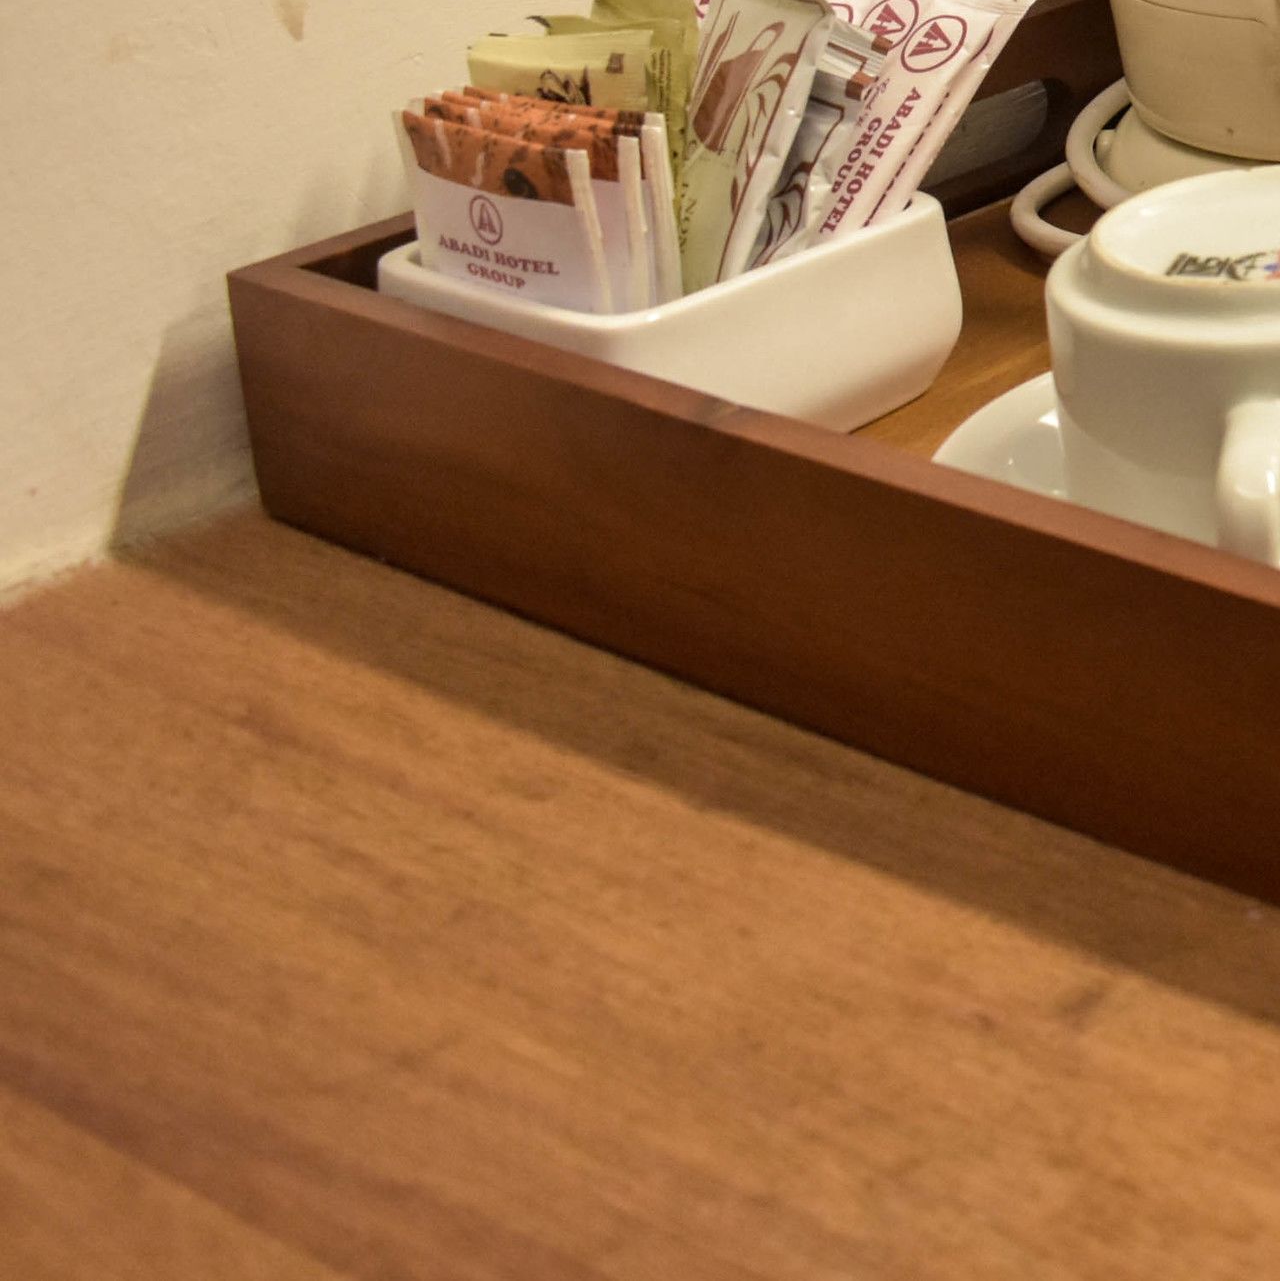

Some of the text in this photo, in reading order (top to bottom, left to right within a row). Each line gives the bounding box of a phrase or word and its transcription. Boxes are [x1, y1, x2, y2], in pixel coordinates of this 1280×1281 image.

[832, 117, 882, 194] GROUP
[870, 87, 922, 158] ABADI
[820, 162, 875, 234] HOTEL
[439, 235, 560, 275] ABADI HOTEL
[468, 262, 526, 289] GROUP
